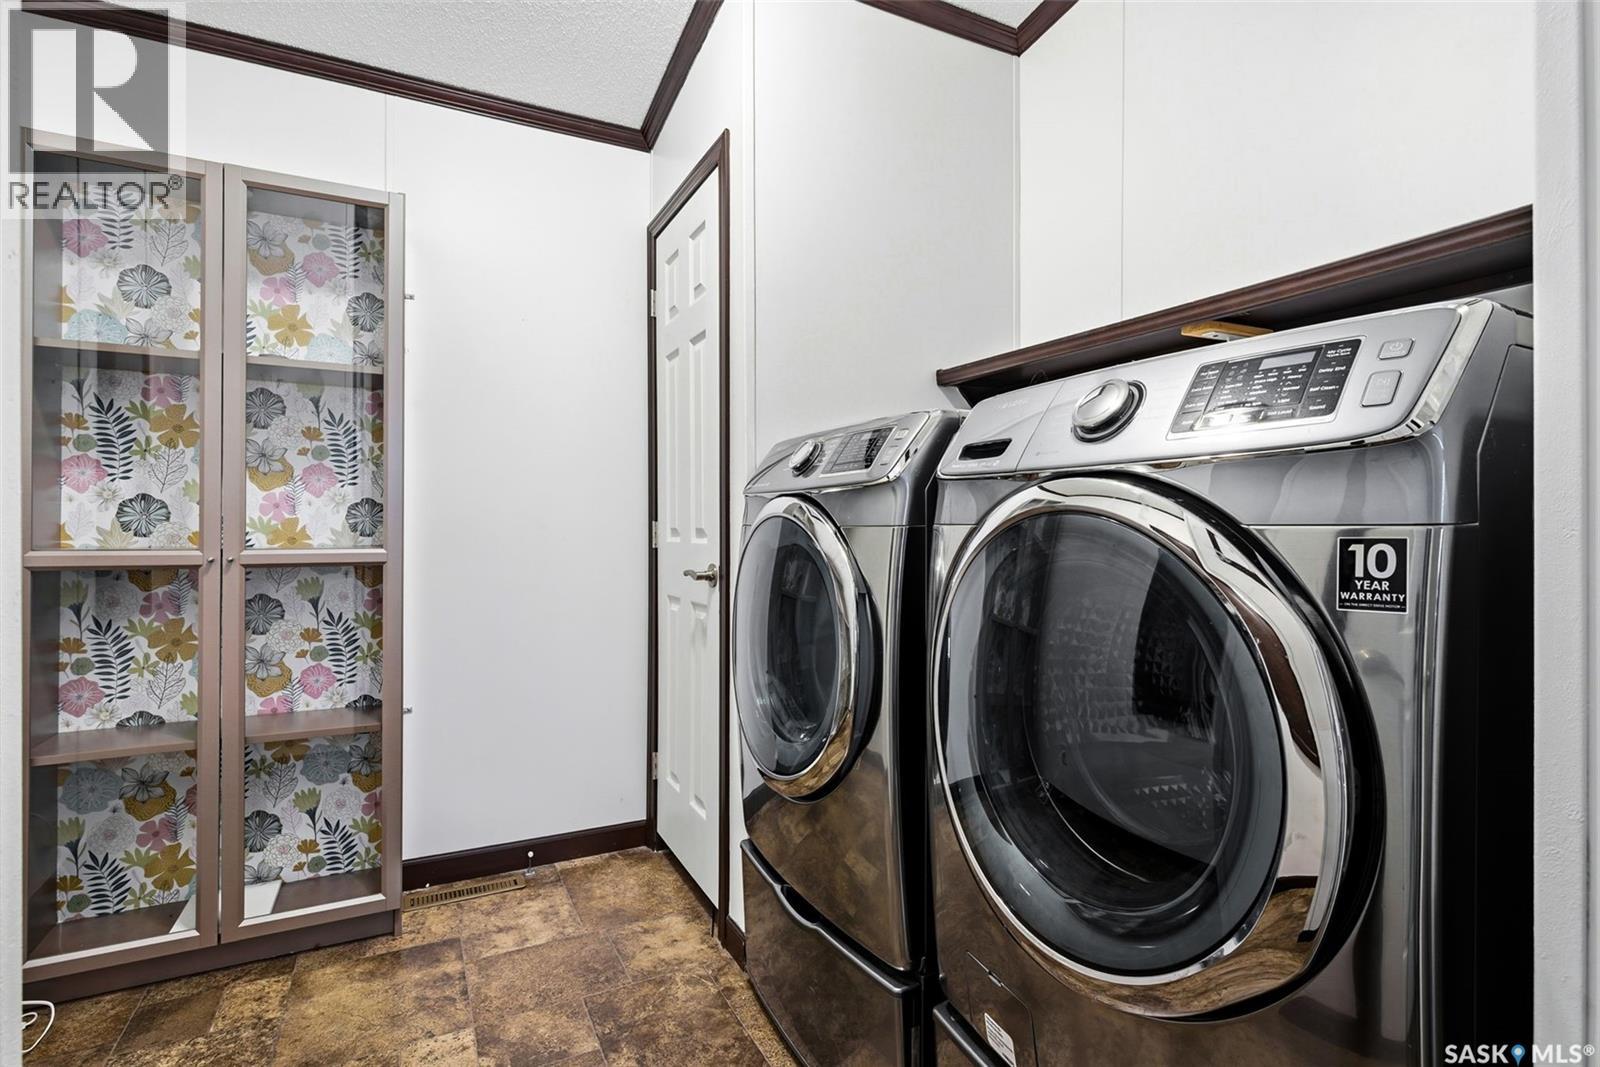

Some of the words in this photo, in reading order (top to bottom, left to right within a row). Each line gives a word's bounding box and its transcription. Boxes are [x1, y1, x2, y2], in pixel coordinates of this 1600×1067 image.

[1348, 543, 1397, 579] 10
[1355, 580, 1389, 590] YEAR
[1340, 591, 1405, 602] WARRANTY
